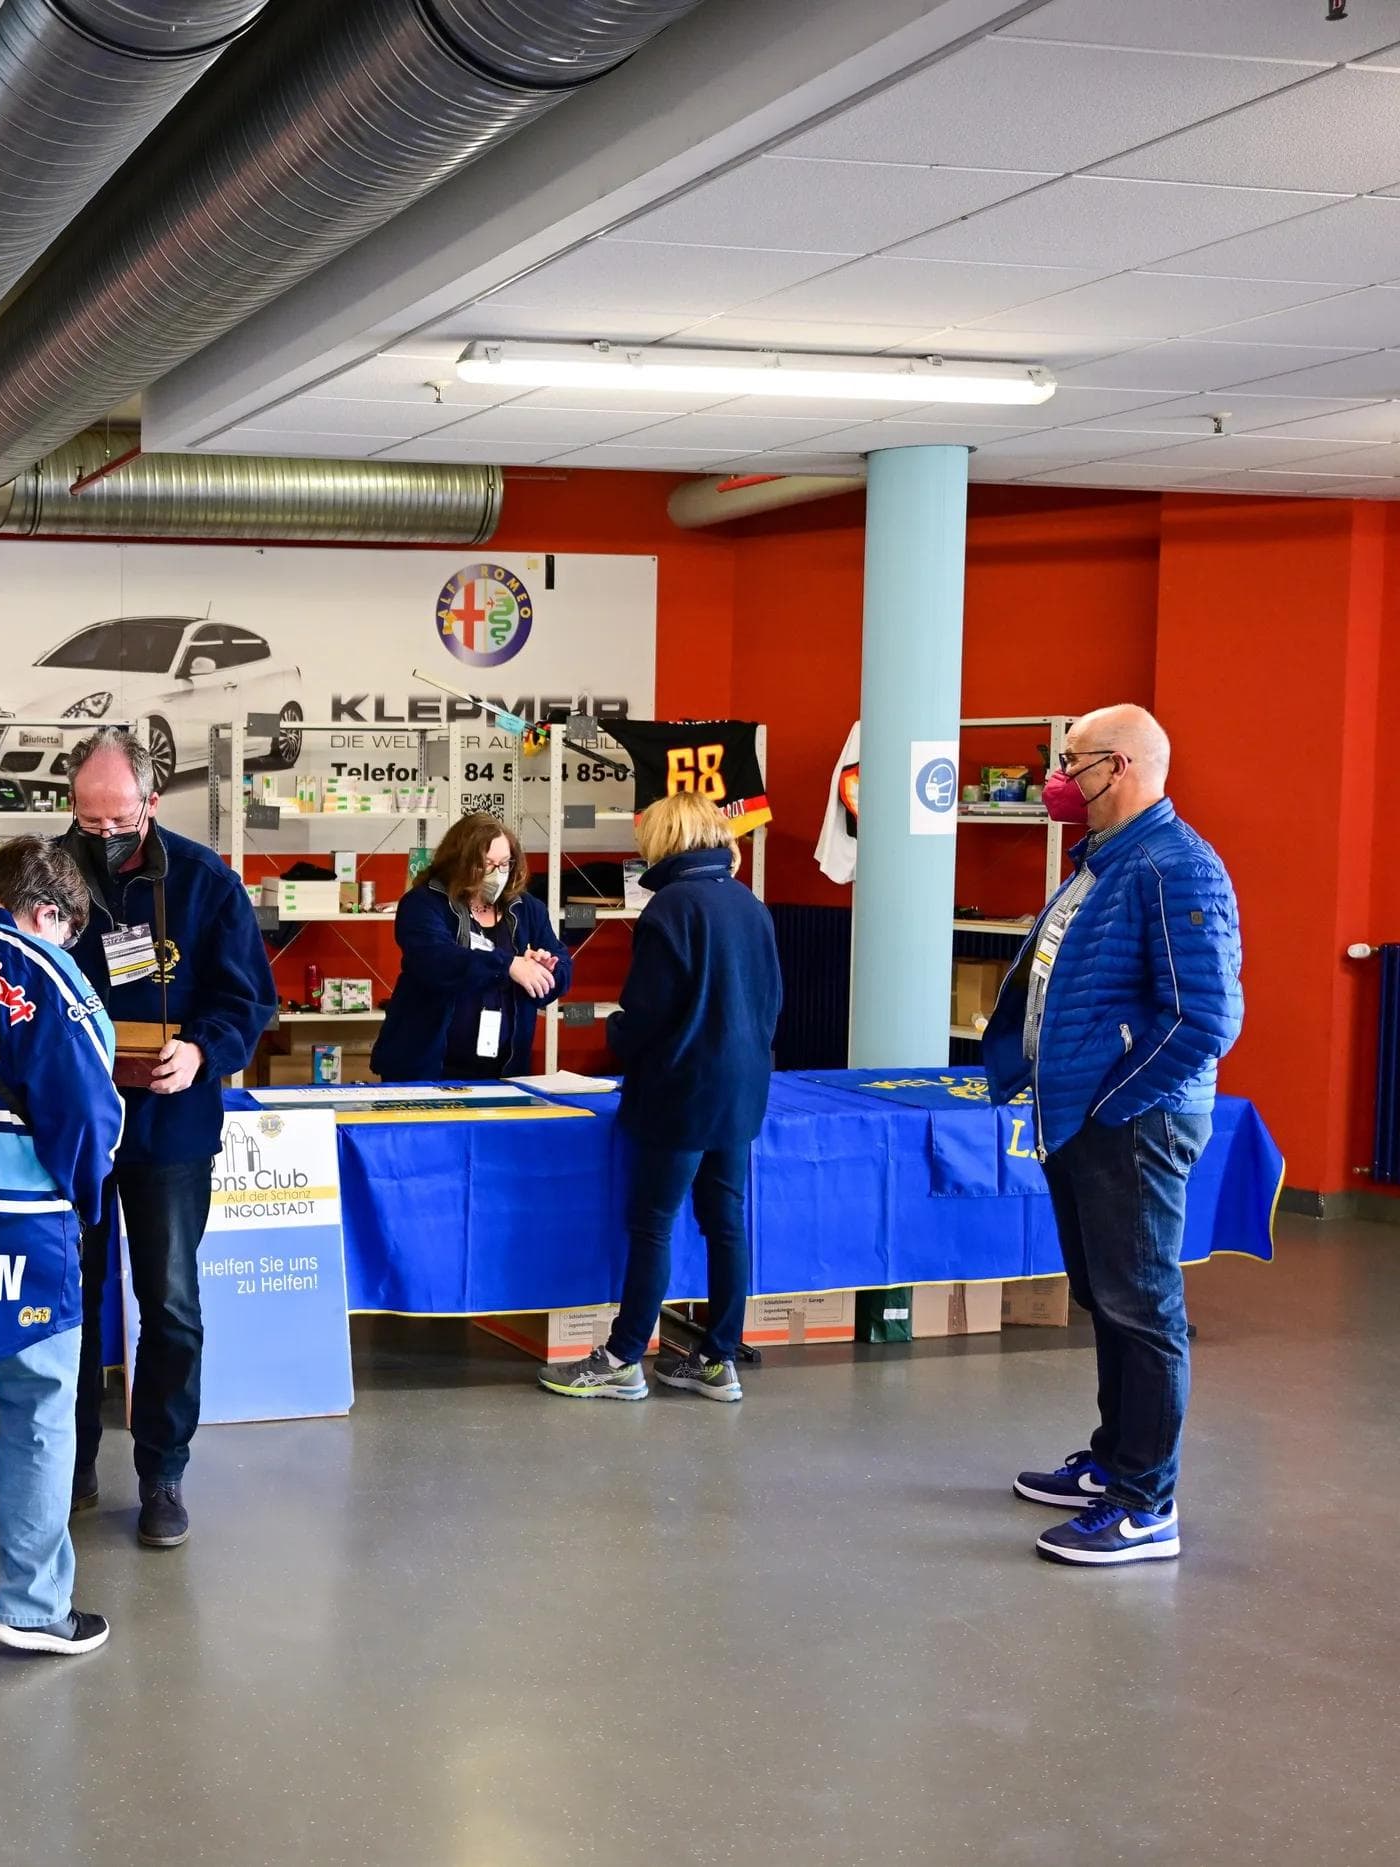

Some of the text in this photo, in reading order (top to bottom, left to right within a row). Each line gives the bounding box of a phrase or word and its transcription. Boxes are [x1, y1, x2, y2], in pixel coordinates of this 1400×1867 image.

[481, 565, 531, 618] ROMEO
[22, 733, 60, 745] Giulietta
[330, 735, 364, 749] DIE
[372, 735, 419, 749] WEL
[667, 744, 727, 800] 68
[211, 1168, 308, 1192] ons Club
[226, 1189, 311, 1203] Auf der Schanz
[224, 1201, 315, 1218] INGOLSTADT
[202, 1256, 318, 1277] Helfen Sie uns
[237, 1274, 319, 1294] zu Helfen!
